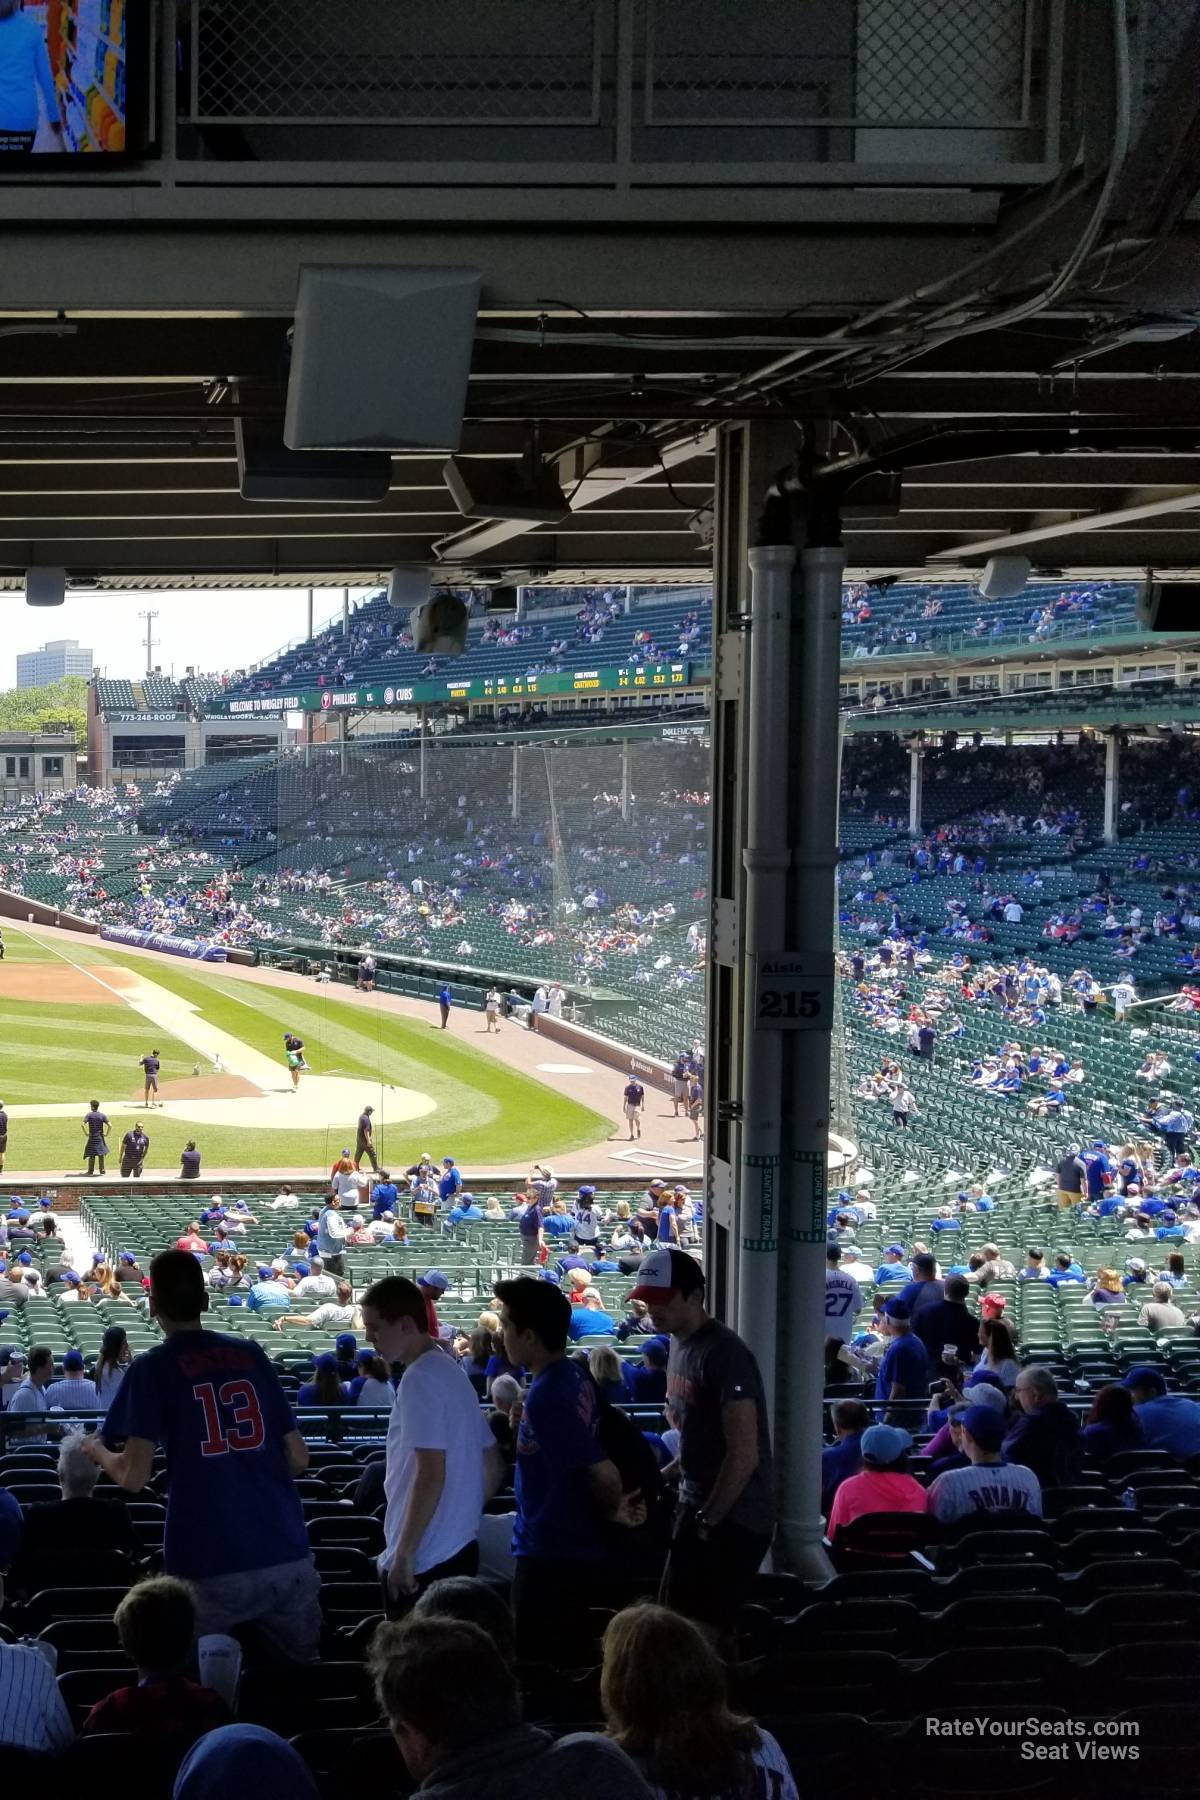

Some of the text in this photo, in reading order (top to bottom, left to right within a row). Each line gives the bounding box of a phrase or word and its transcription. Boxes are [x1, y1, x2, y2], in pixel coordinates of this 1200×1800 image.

[230, 697, 298, 712] WELCOME TO WRIGLEY FIELD
[332, 694, 357, 705] PHILLIES
[396, 688, 413, 700] CUBS
[761, 962, 803, 973] Aisle
[760, 991, 821, 1018] 215
[761, 1168, 772, 1240] SANITARY DRAIN
[814, 1166, 823, 1230] STORM WATER
[825, 1293, 853, 1317] 27
[193, 1379, 266, 1456] 13
